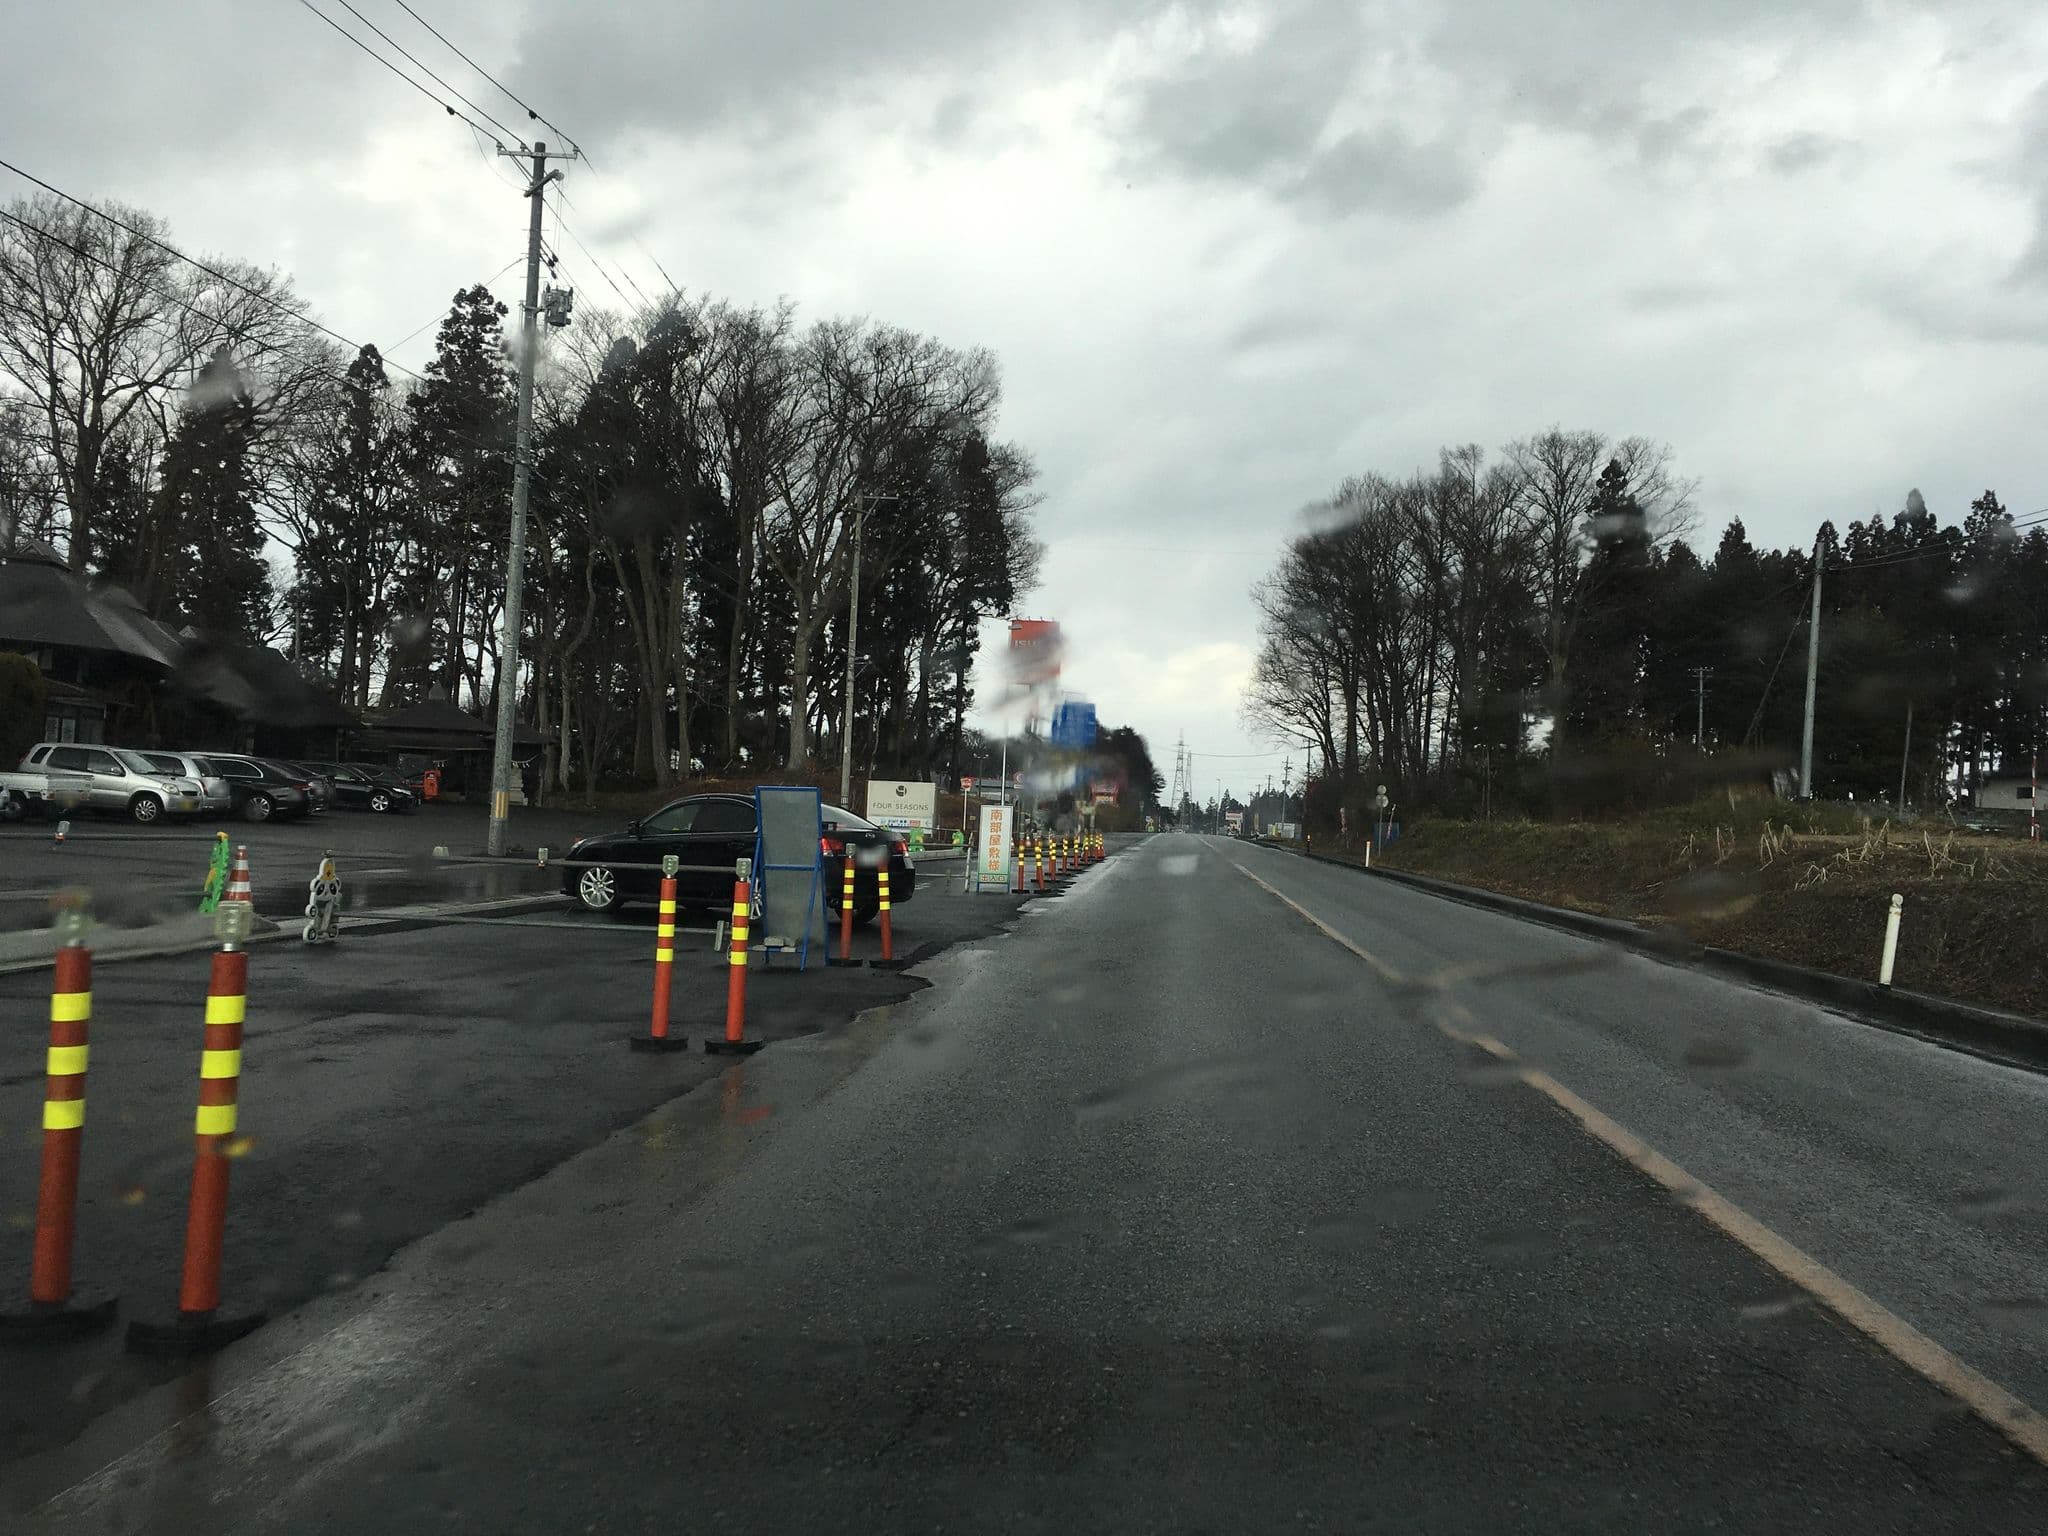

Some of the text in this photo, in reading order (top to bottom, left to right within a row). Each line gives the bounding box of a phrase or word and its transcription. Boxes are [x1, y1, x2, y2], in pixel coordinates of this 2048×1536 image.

[895, 803, 929, 811] SEASONS
[988, 809, 1003, 871] 南部屋敷様
